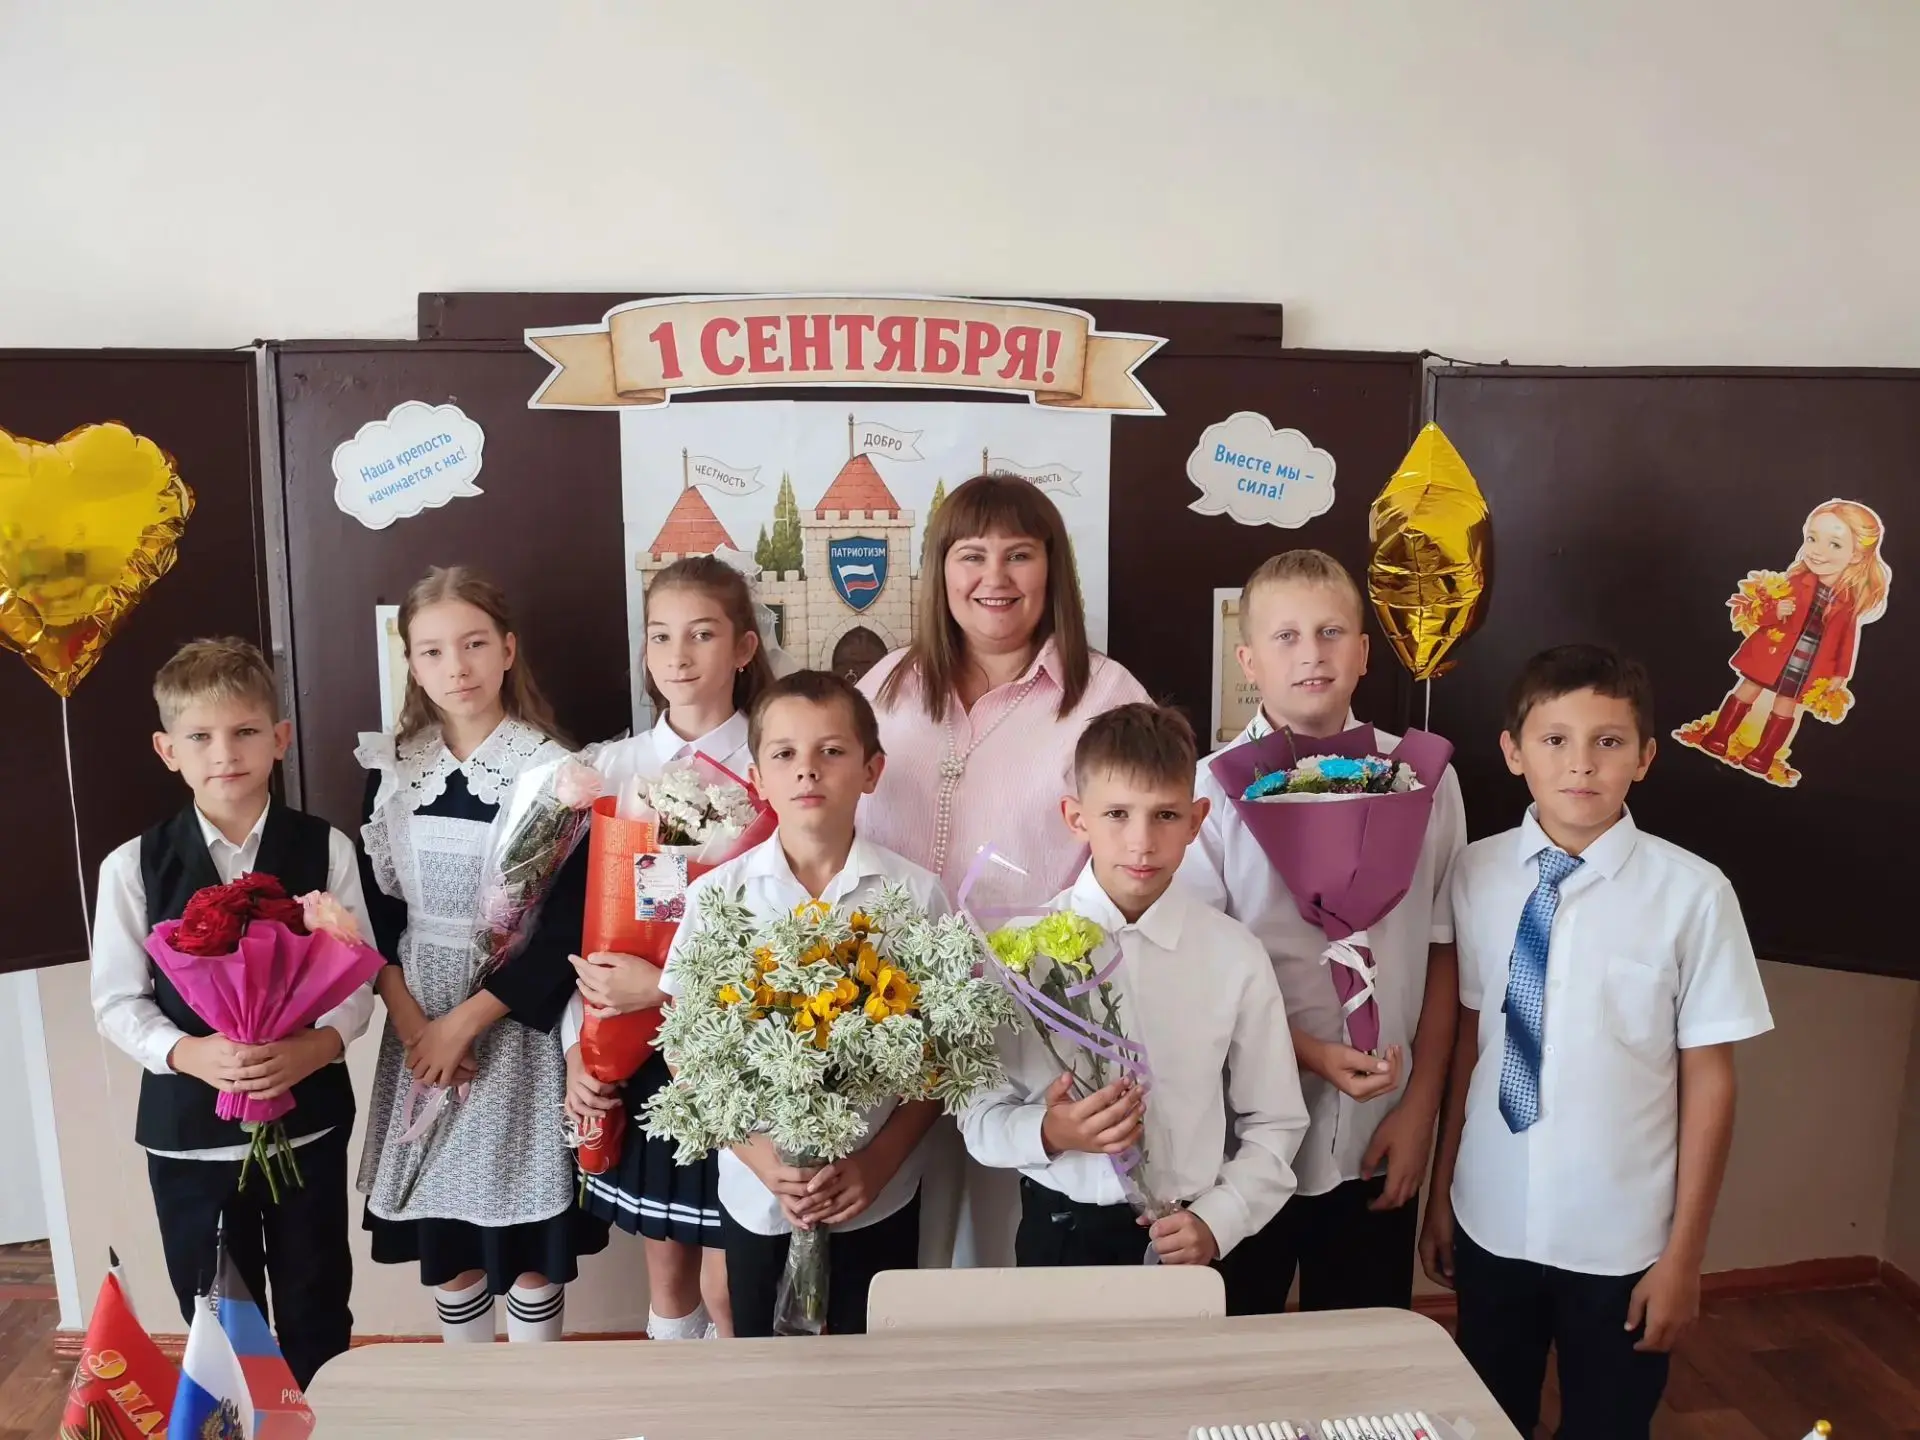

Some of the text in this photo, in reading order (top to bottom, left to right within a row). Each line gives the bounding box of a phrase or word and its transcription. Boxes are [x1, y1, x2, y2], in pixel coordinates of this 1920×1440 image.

[649, 314, 1062, 384] 1 СЕНТЯБРЯ!
[360, 433, 452, 482] Наша крепость
[863, 433, 903, 451] ДОБРО
[369, 445, 468, 504] начинается с нас!
[695, 464, 746, 488] ЧЕСТНОСТЬ
[1215, 444, 1271, 473] Вместе
[1275, 463, 1301, 481] мы
[1237, 477, 1285, 500] сила!
[831, 546, 886, 558] ПАТРИОТИЗМ
[87, 1349, 169, 1440] 9 МА
